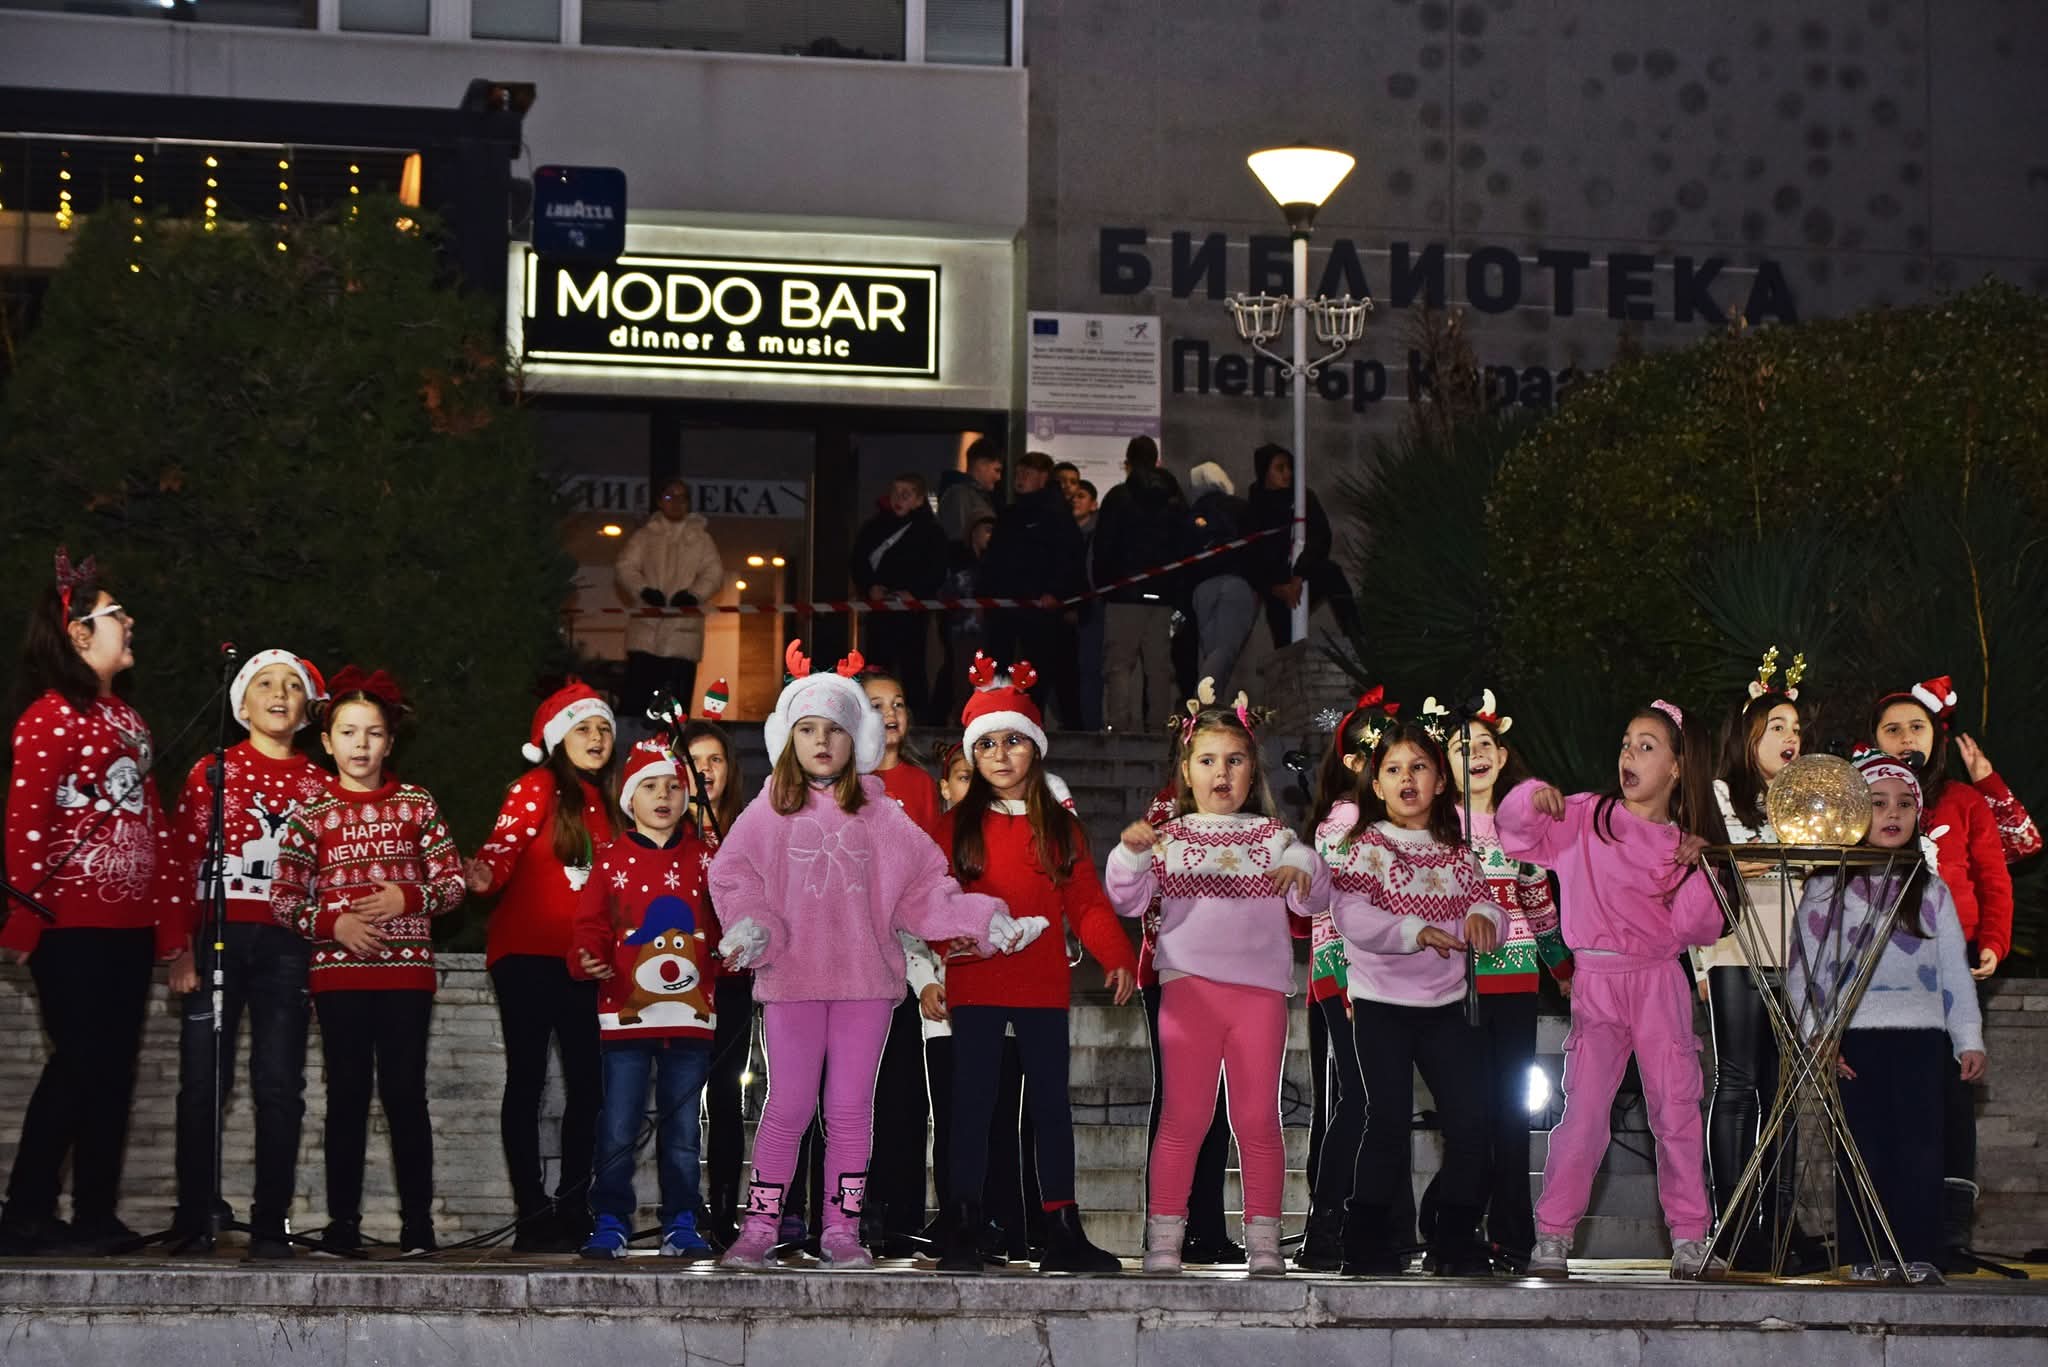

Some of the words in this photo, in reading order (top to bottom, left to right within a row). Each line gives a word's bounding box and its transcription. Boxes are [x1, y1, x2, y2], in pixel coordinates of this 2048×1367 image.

[1098, 227, 1798, 325] БИБЛИОТЕКА
[557, 268, 762, 325] MODO
[780, 279, 907, 333] BAR
[609, 325, 714, 351] dinner
[726, 330, 746, 353] &
[759, 334, 850, 357] music
[342, 822, 403, 841] HAPPY
[328, 841, 369, 863] NEW
[370, 840, 414, 856] YEAR
